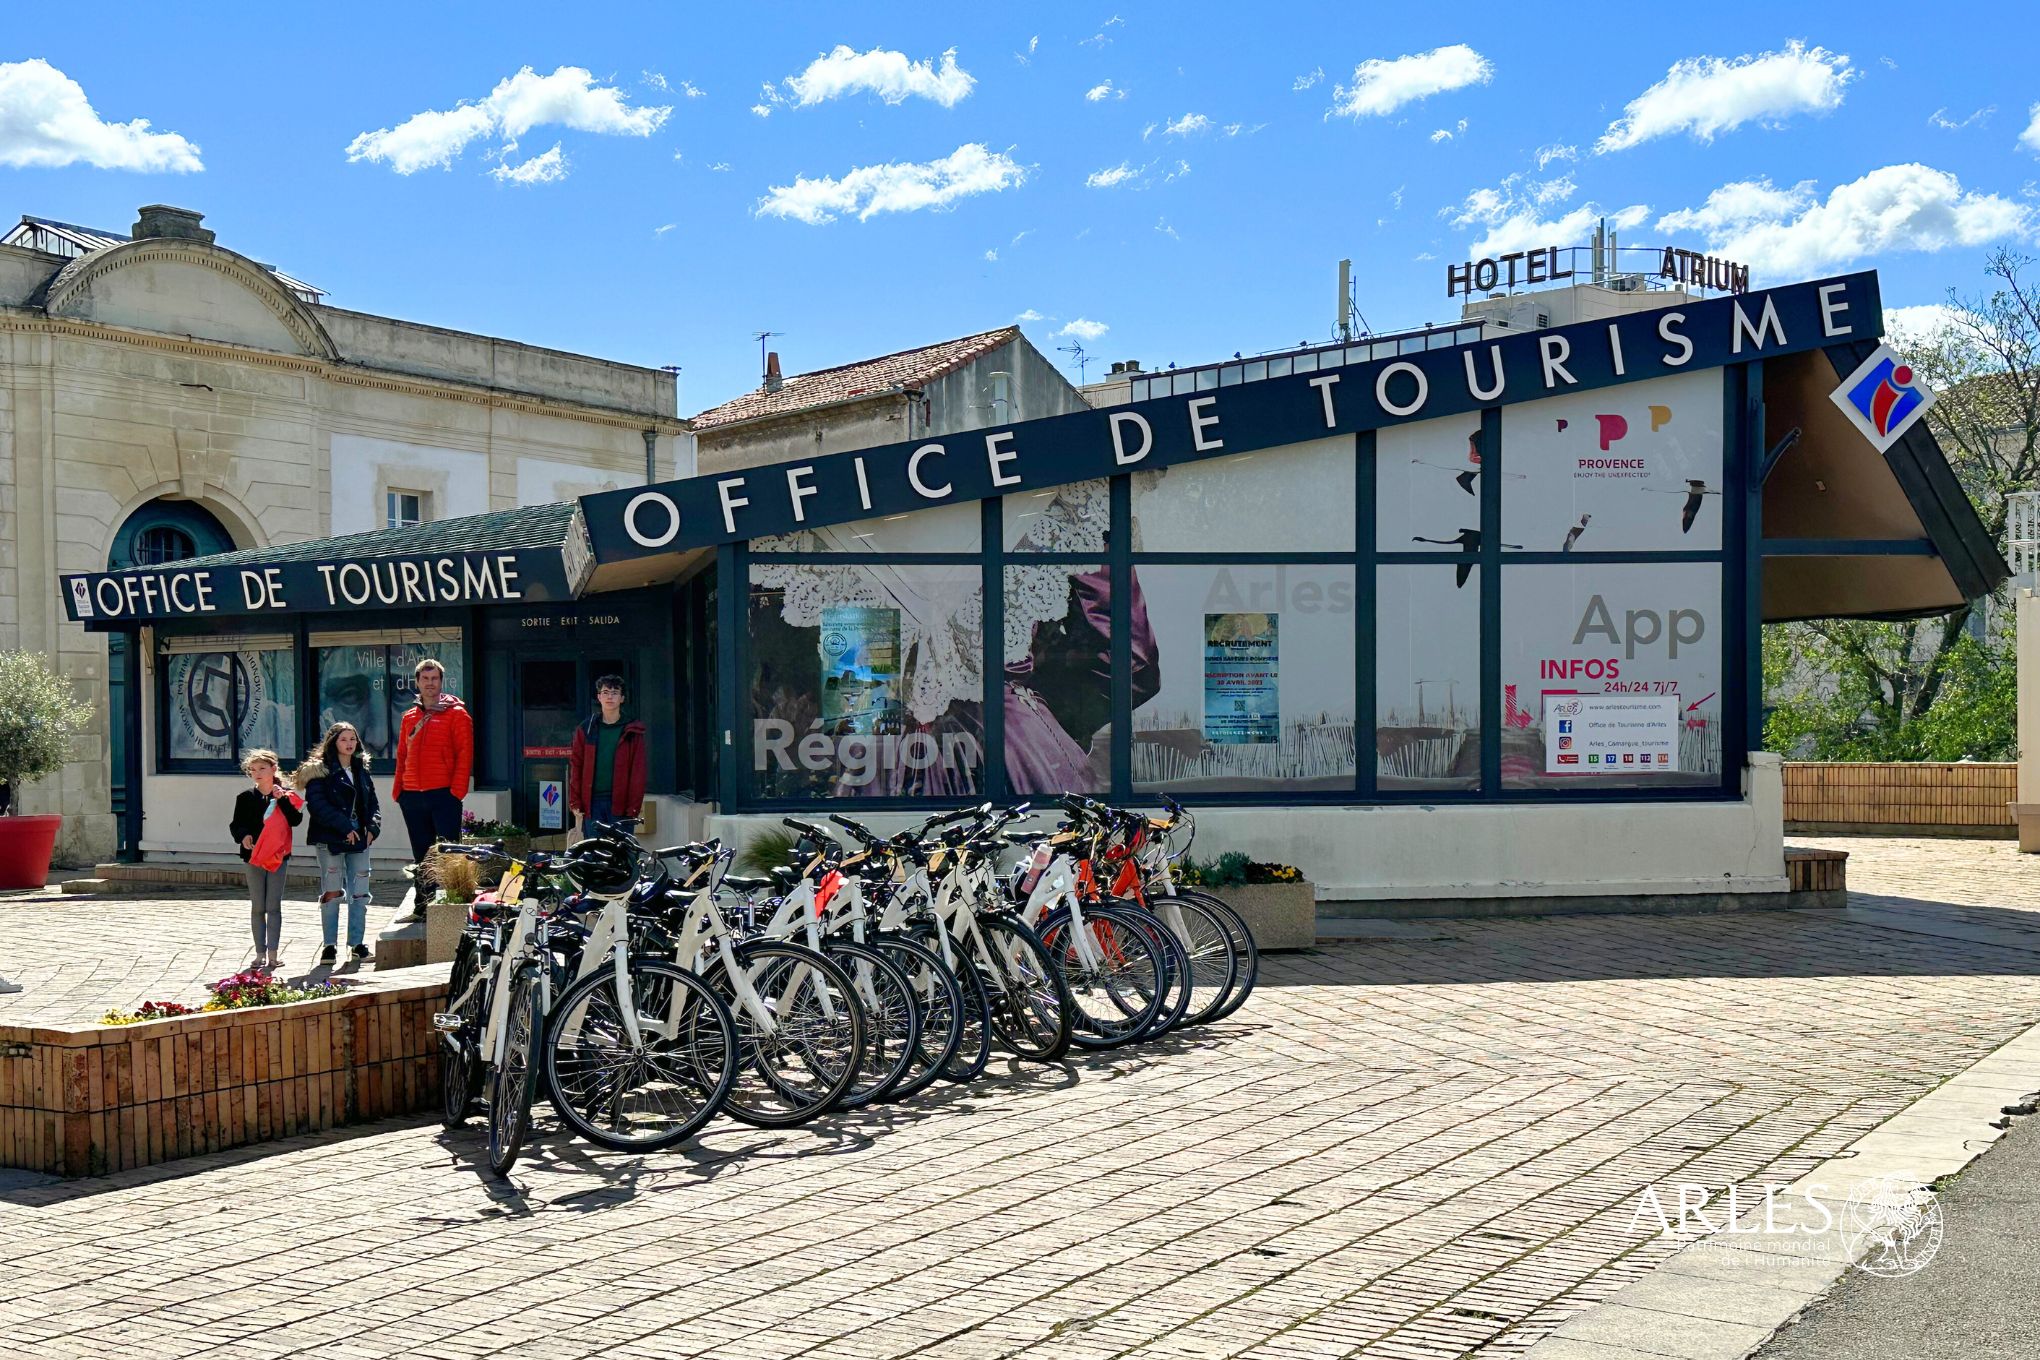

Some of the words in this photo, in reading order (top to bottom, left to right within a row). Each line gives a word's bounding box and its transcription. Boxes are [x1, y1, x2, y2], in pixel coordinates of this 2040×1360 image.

[1447, 246, 1573, 297] HOTEL
[1660, 246, 1749, 294] ATRIUM
[623, 432, 1021, 548] OFFICE
[1109, 396, 1224, 466] DE
[1308, 283, 1852, 429] TOURISME
[1579, 459, 1645, 469] PROVENCE
[96, 572, 216, 617] OFFICE
[240, 569, 286, 610] DE
[317, 555, 521, 606] TOURISME
[1200, 565, 1355, 614] Arles
[521, 617, 551, 627] SORTIE
[560, 616, 578, 625] EXIT
[589, 615, 620, 625] SALIDA
[1572, 595, 1706, 660] App
[1207, 640, 1273, 648] RECRUTEMENT
[357, 650, 385, 668] Ville
[1540, 658, 1620, 679] INFOS
[372, 675, 384, 690] et
[1604, 681, 1649, 693] 24h/24
[1653, 681, 1678, 695] 7j/7
[179, 704, 195, 738] WORLD
[753, 718, 978, 787] Région
